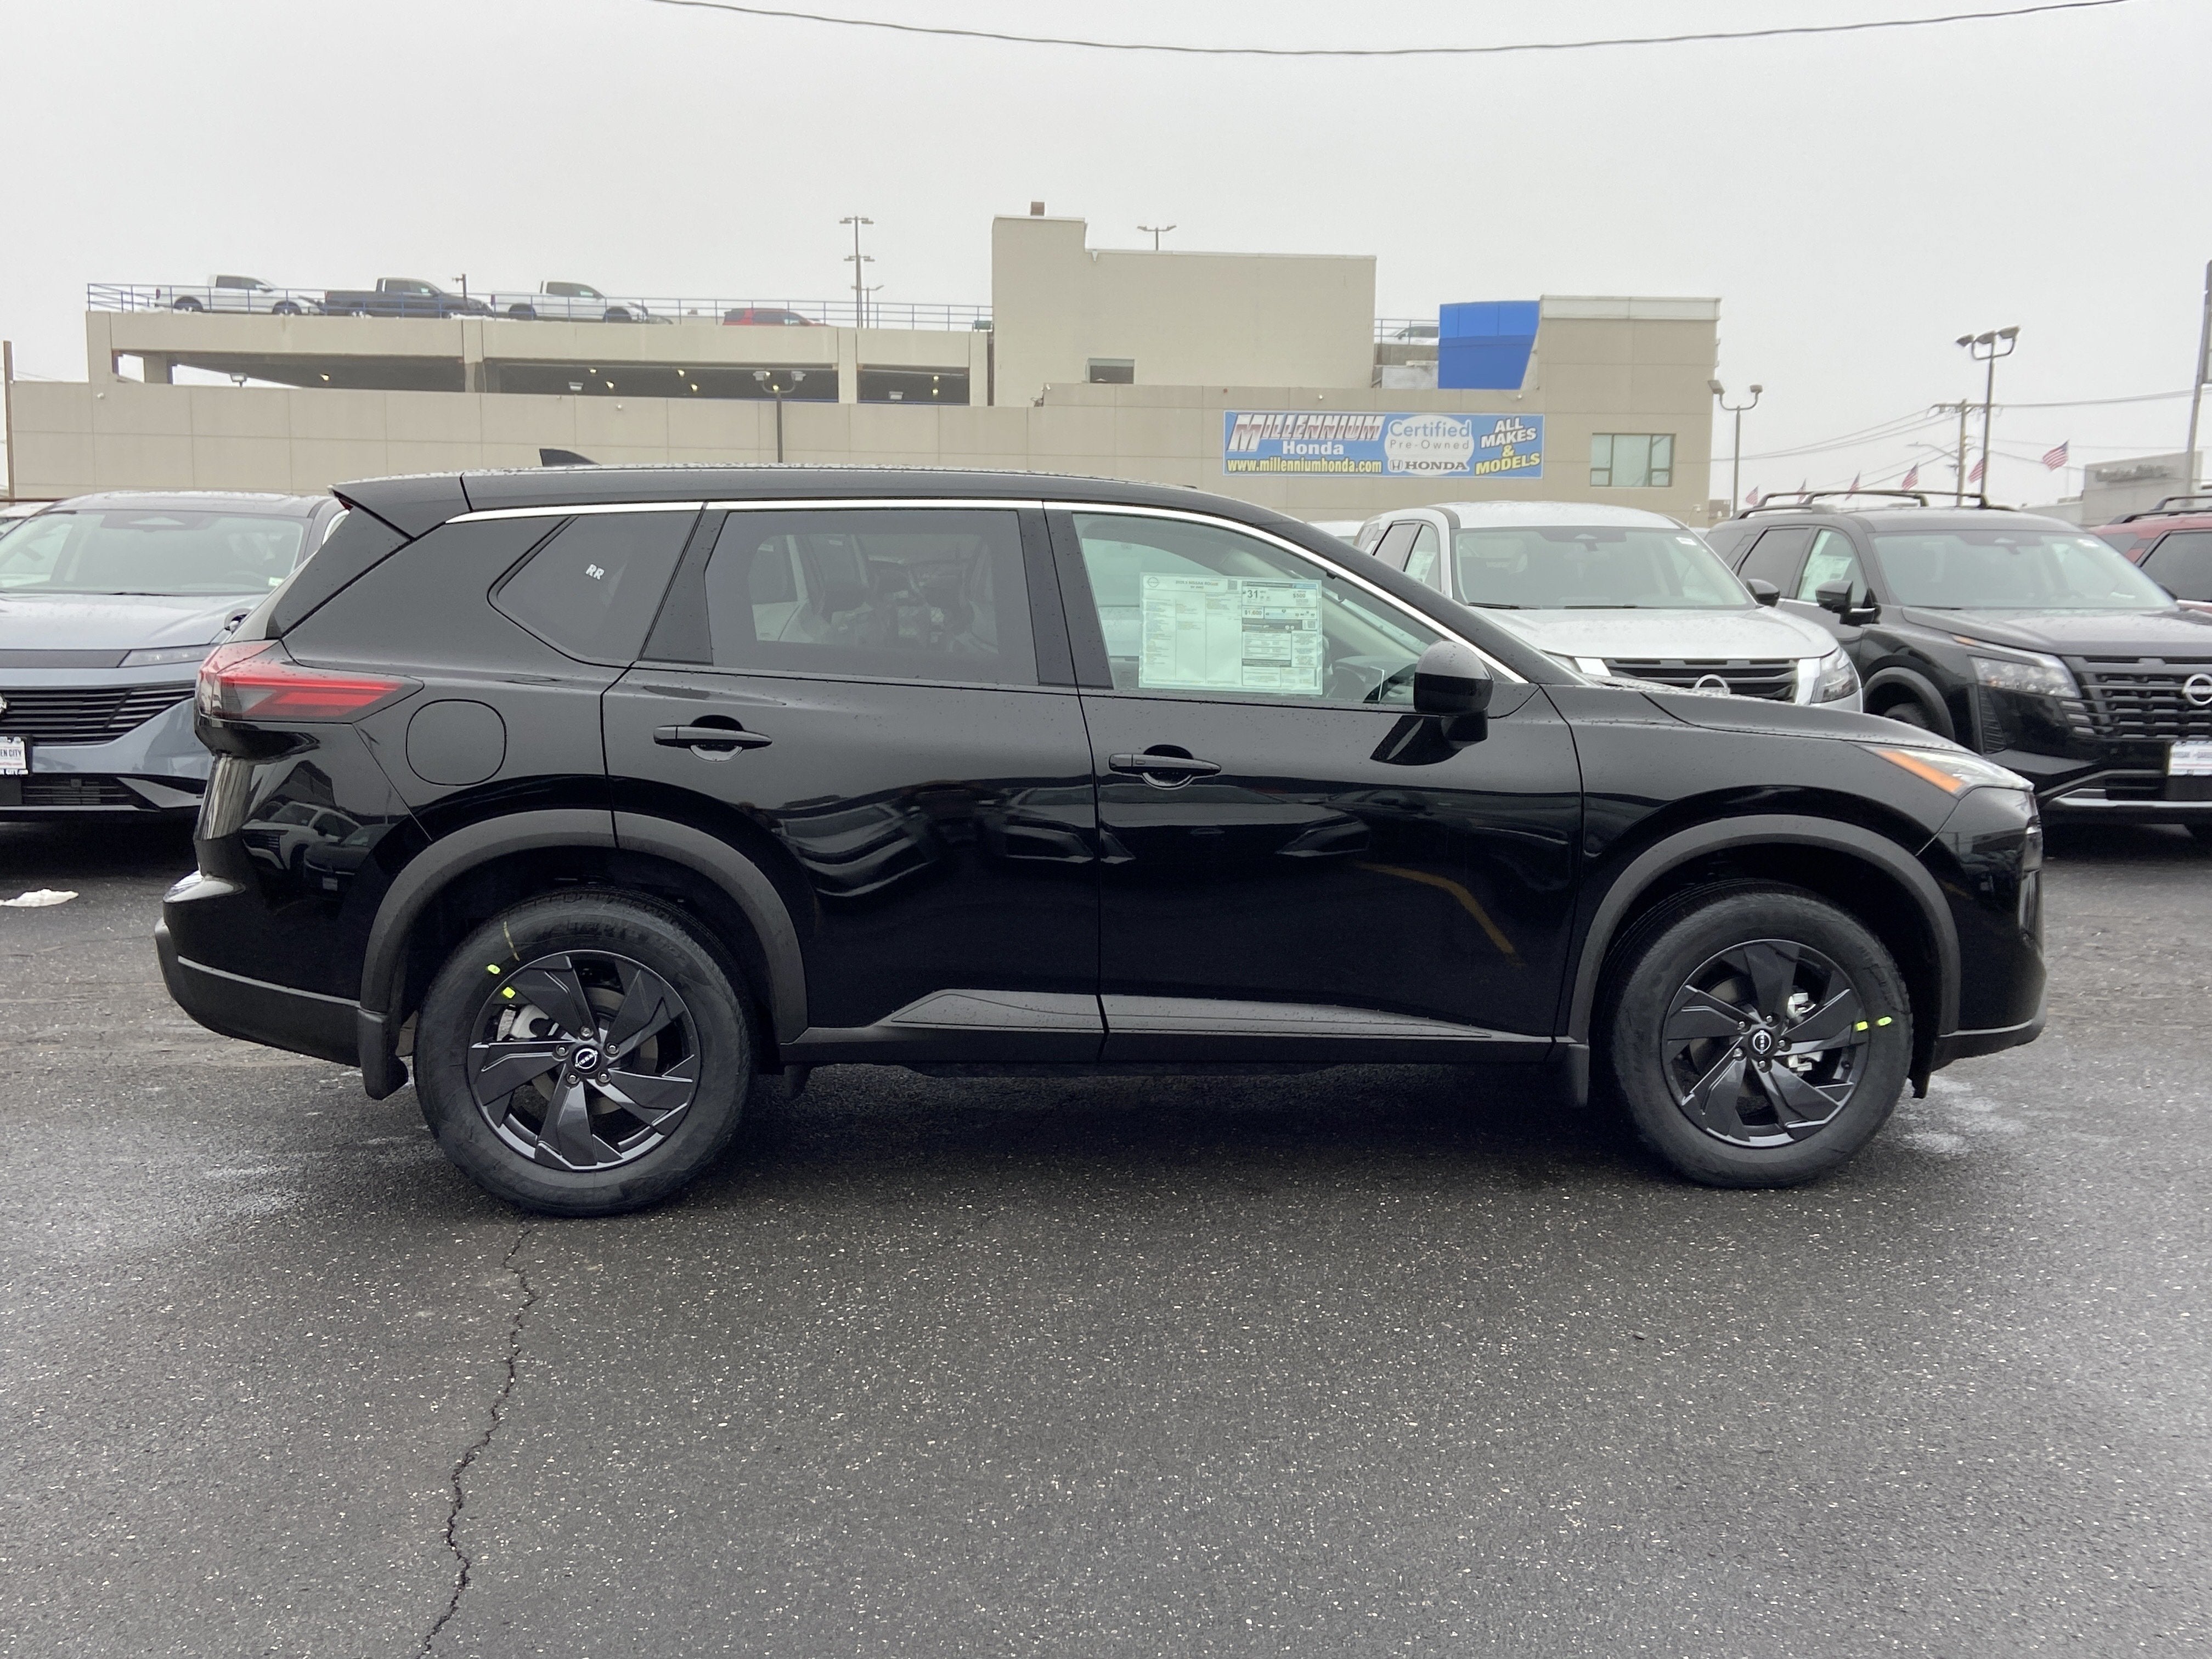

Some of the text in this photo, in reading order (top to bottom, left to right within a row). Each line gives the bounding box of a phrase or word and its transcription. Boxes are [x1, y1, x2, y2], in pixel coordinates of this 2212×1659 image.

[1227, 414, 1385, 452] MILLENNIUM
[1390, 420, 1470, 437] Certified
[1494, 417, 1524, 433] ALL
[1390, 439, 1469, 449] Pre-Owned
[1481, 427, 1537, 448] MAKES
[1282, 441, 1344, 455] Honda
[1502, 444, 1515, 458] &
[1227, 456, 1382, 473] www.millenniumhonda.com
[1404, 461, 1468, 471] HONDA
[1475, 453, 1541, 475] MODELS
[586, 564, 605, 580] RR
[1247, 590, 1258, 599] 31
[9, 749, 22, 757] CITY
